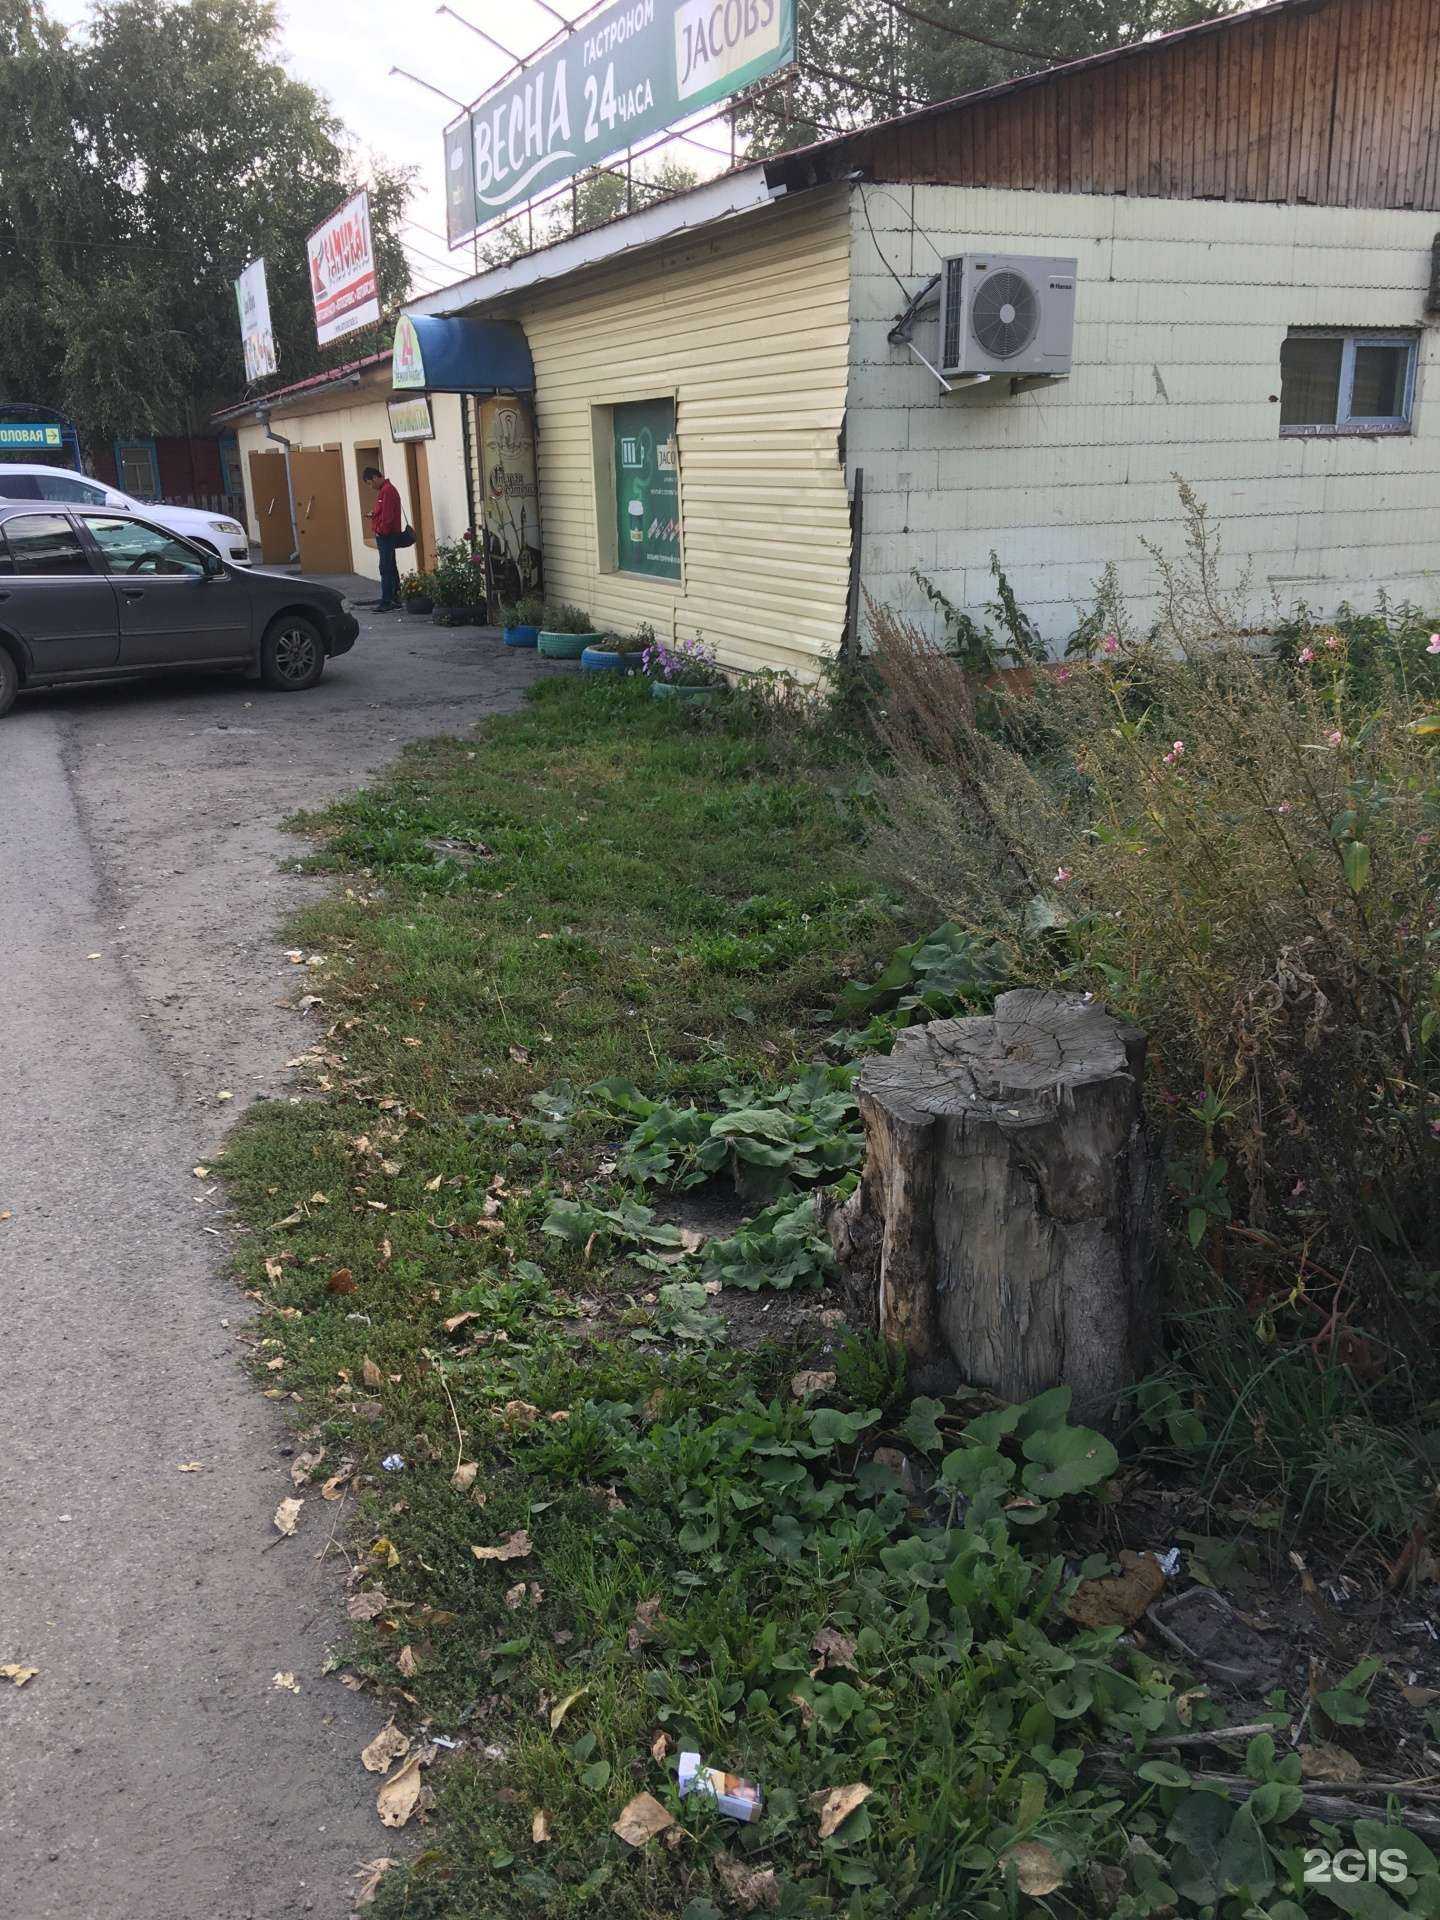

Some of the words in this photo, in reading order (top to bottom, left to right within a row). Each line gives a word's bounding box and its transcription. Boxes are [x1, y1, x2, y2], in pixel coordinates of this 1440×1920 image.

[583, 0, 654, 67] ГАСТРОНОМ
[682, 0, 774, 84] JACOBS
[474, 59, 571, 194] ВЕСНА
[584, 61, 617, 143] 24
[617, 78, 654, 122] ЧАСА
[0, 429, 43, 442] ОЛОВАЯ
